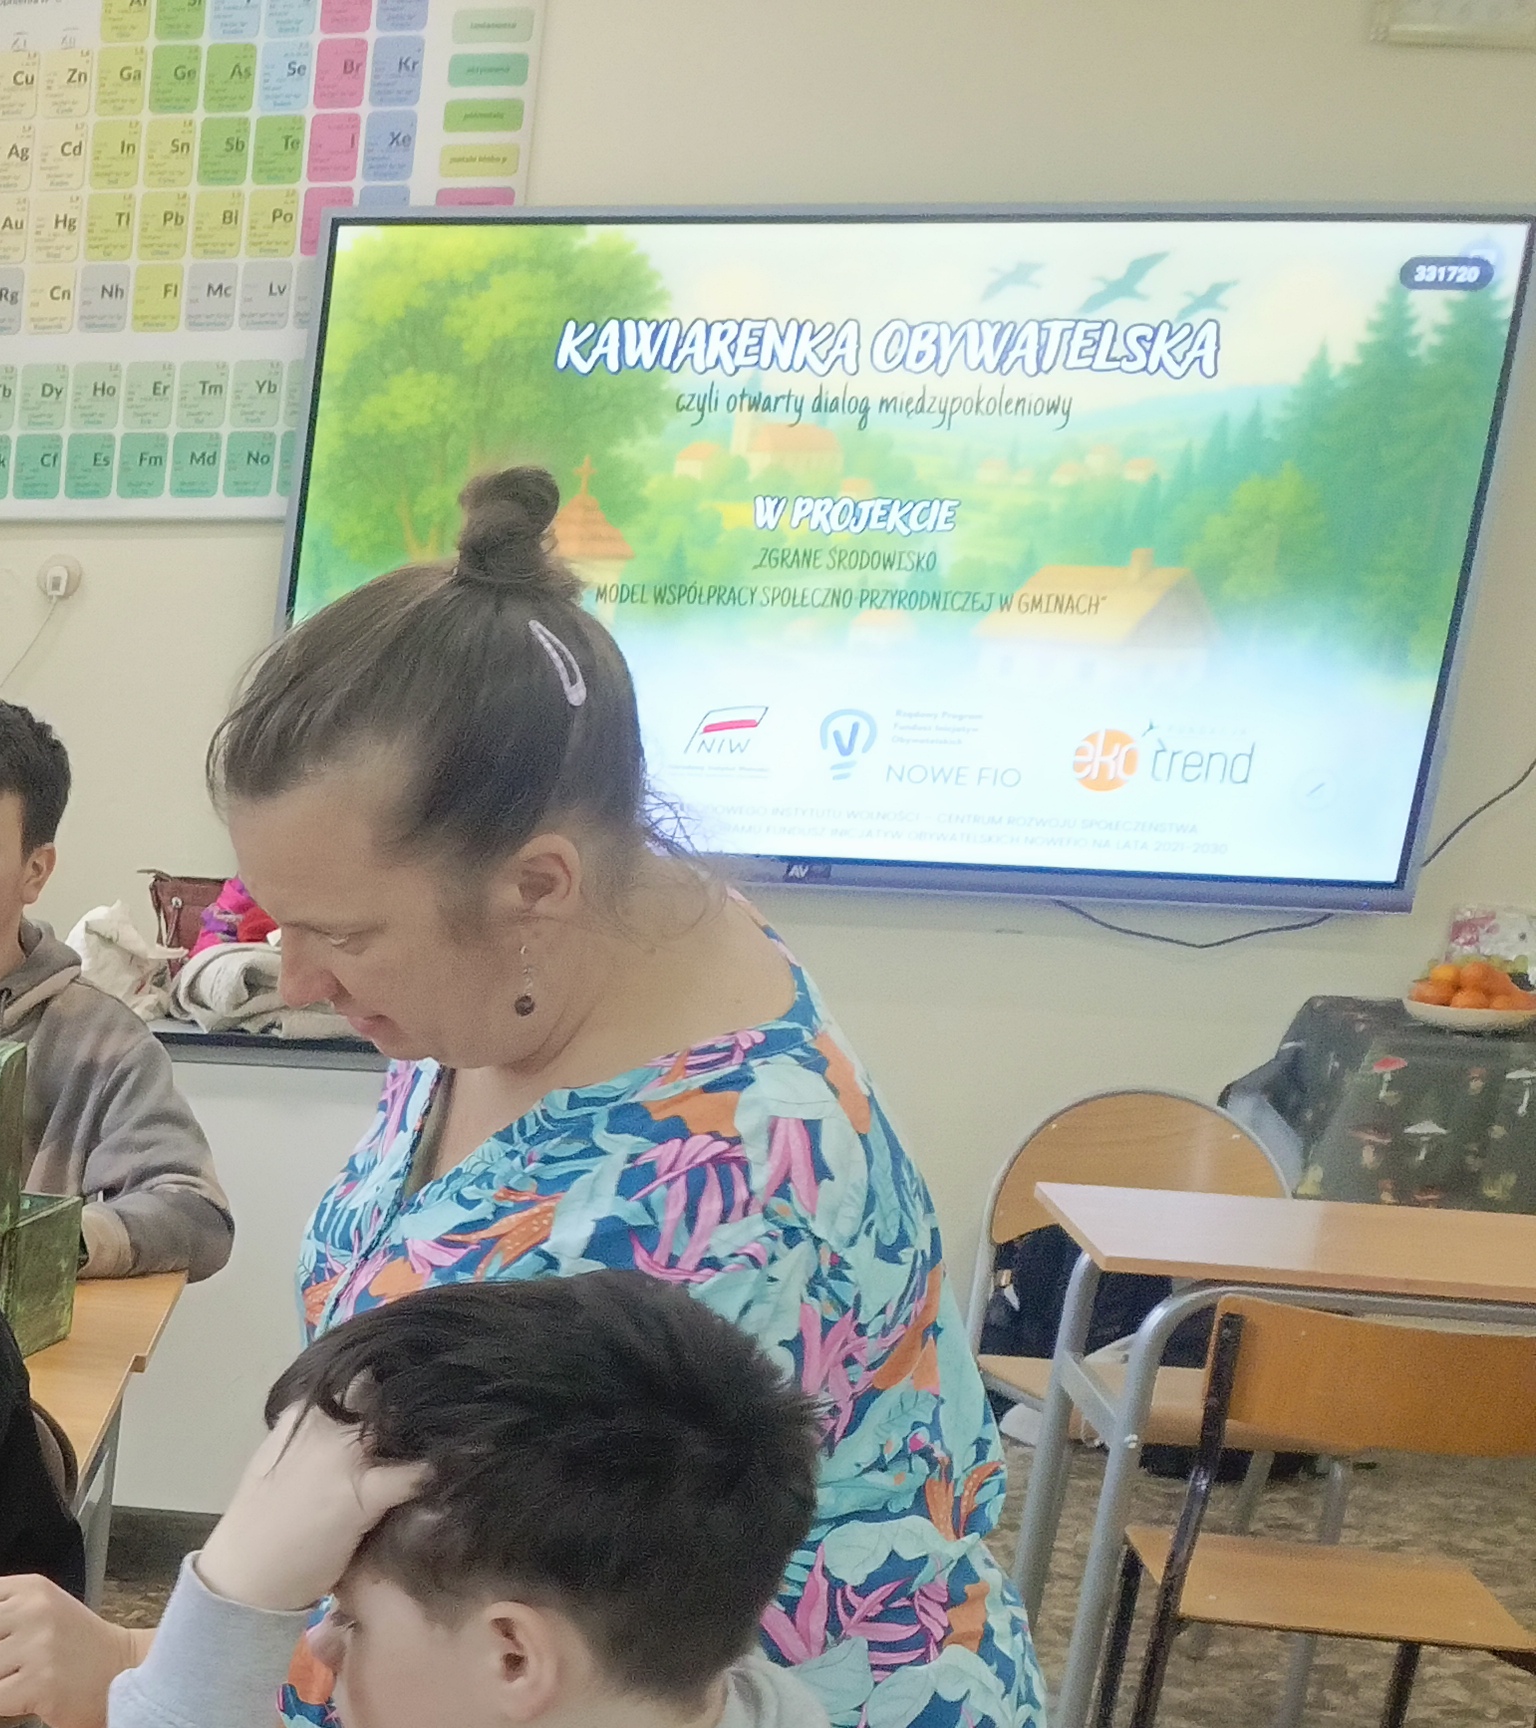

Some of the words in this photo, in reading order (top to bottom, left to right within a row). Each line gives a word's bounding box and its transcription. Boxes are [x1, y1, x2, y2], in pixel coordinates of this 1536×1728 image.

[230, 63, 251, 79] As
[287, 61, 306, 77] Se
[343, 60, 362, 74] Br
[398, 57, 420, 72] Kr
[12, 71, 34, 86] Cu
[67, 69, 87, 83] Zn
[120, 66, 141, 82] Ga
[174, 65, 196, 81] Ge
[170, 139, 190, 154] Sn
[225, 137, 245, 152] Sb
[283, 135, 301, 150] Te
[389, 132, 411, 147] Xe
[8, 143, 30, 161] Ag
[61, 141, 82, 157] Cd
[120, 140, 136, 155] In
[1, 216, 24, 231] Au
[55, 214, 77, 232] Hg
[163, 211, 184, 226] Pb
[272, 209, 293, 224] Po
[50, 286, 71, 301] Cn
[101, 285, 124, 299] Nh
[207, 282, 232, 297] Mc
[269, 281, 286, 296] Lv
[0, 288, 19, 305] Rg
[554, 318, 860, 377] KAWIARENKA
[870, 318, 1221, 378] OBYWATELSKA
[41, 383, 63, 400] Dy
[93, 382, 116, 397] Ho
[153, 381, 170, 396] Er
[198, 381, 223, 395] Tm
[256, 380, 277, 395] Yb
[675, 382, 719, 426] czyli
[726, 387, 804, 427] otwarty
[812, 383, 871, 430] dialog
[878, 383, 1074, 431] międzypokoleniowy
[40, 452, 58, 468] Cf
[93, 452, 110, 467] Es
[139, 452, 163, 466] Fm
[190, 451, 216, 466] Md
[247, 451, 270, 466] No
[753, 495, 788, 530] W
[790, 496, 962, 537] PROJEKCIE
[826, 544, 938, 573] ŚRODOWISKO
[595, 583, 649, 605] MODEL
[653, 580, 756, 608] WSPÓŁPRACY
[999, 593, 1015, 613] W
[696, 737, 752, 754] NIW
[1072, 729, 1139, 783] eko
[1150, 738, 1256, 785] trend
[885, 763, 969, 786] NOWE
[976, 766, 1022, 788] FIO
